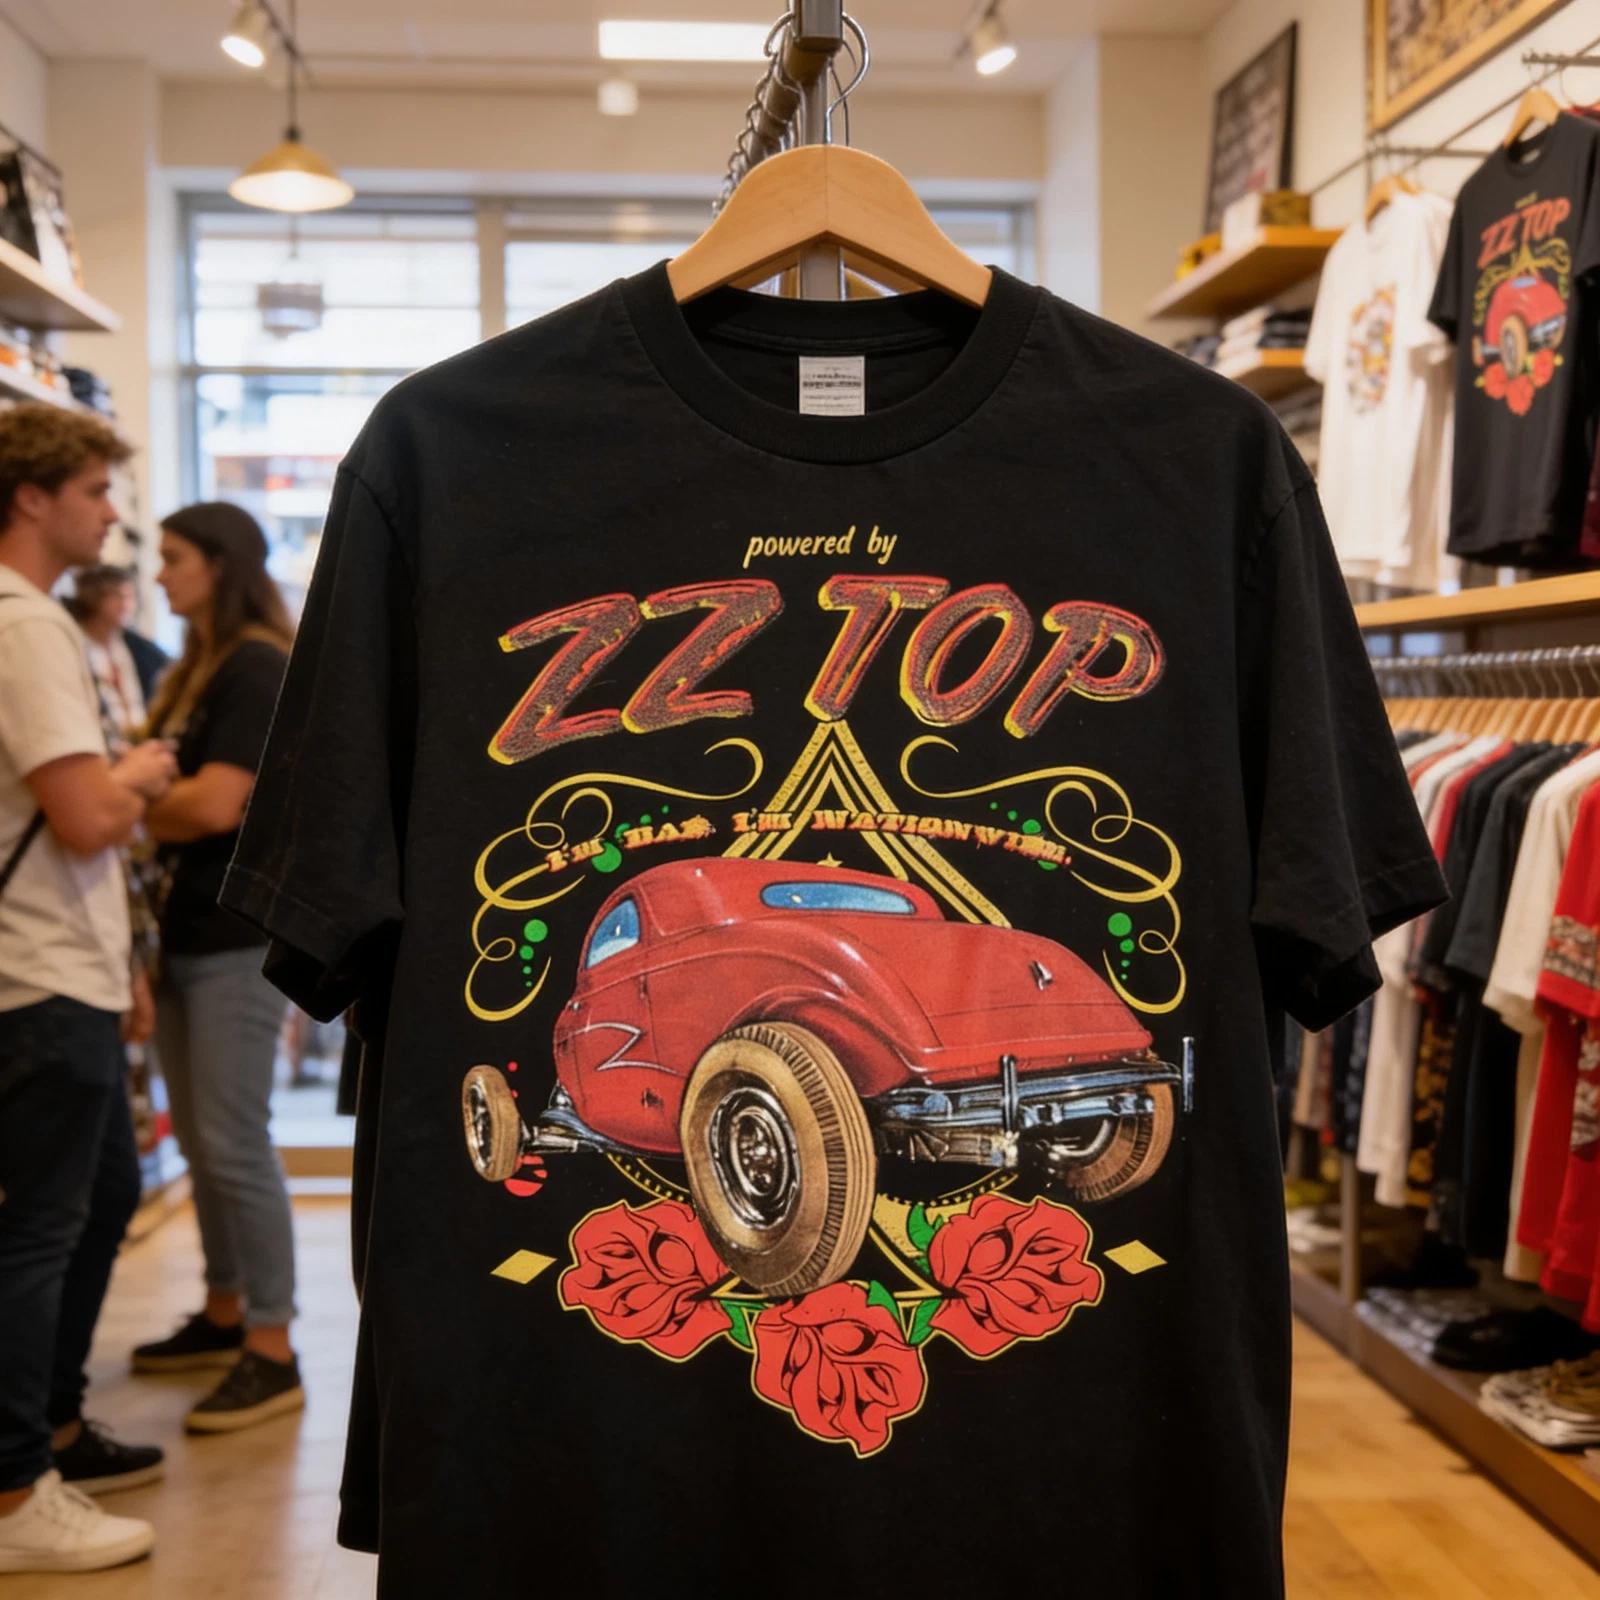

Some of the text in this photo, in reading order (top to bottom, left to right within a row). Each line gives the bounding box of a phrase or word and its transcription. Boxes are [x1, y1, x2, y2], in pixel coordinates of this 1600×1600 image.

[1478, 197, 1570, 269] ZZ TOP
[742, 525, 898, 569] powered by
[488, 574, 1164, 765] ZZ TOP
